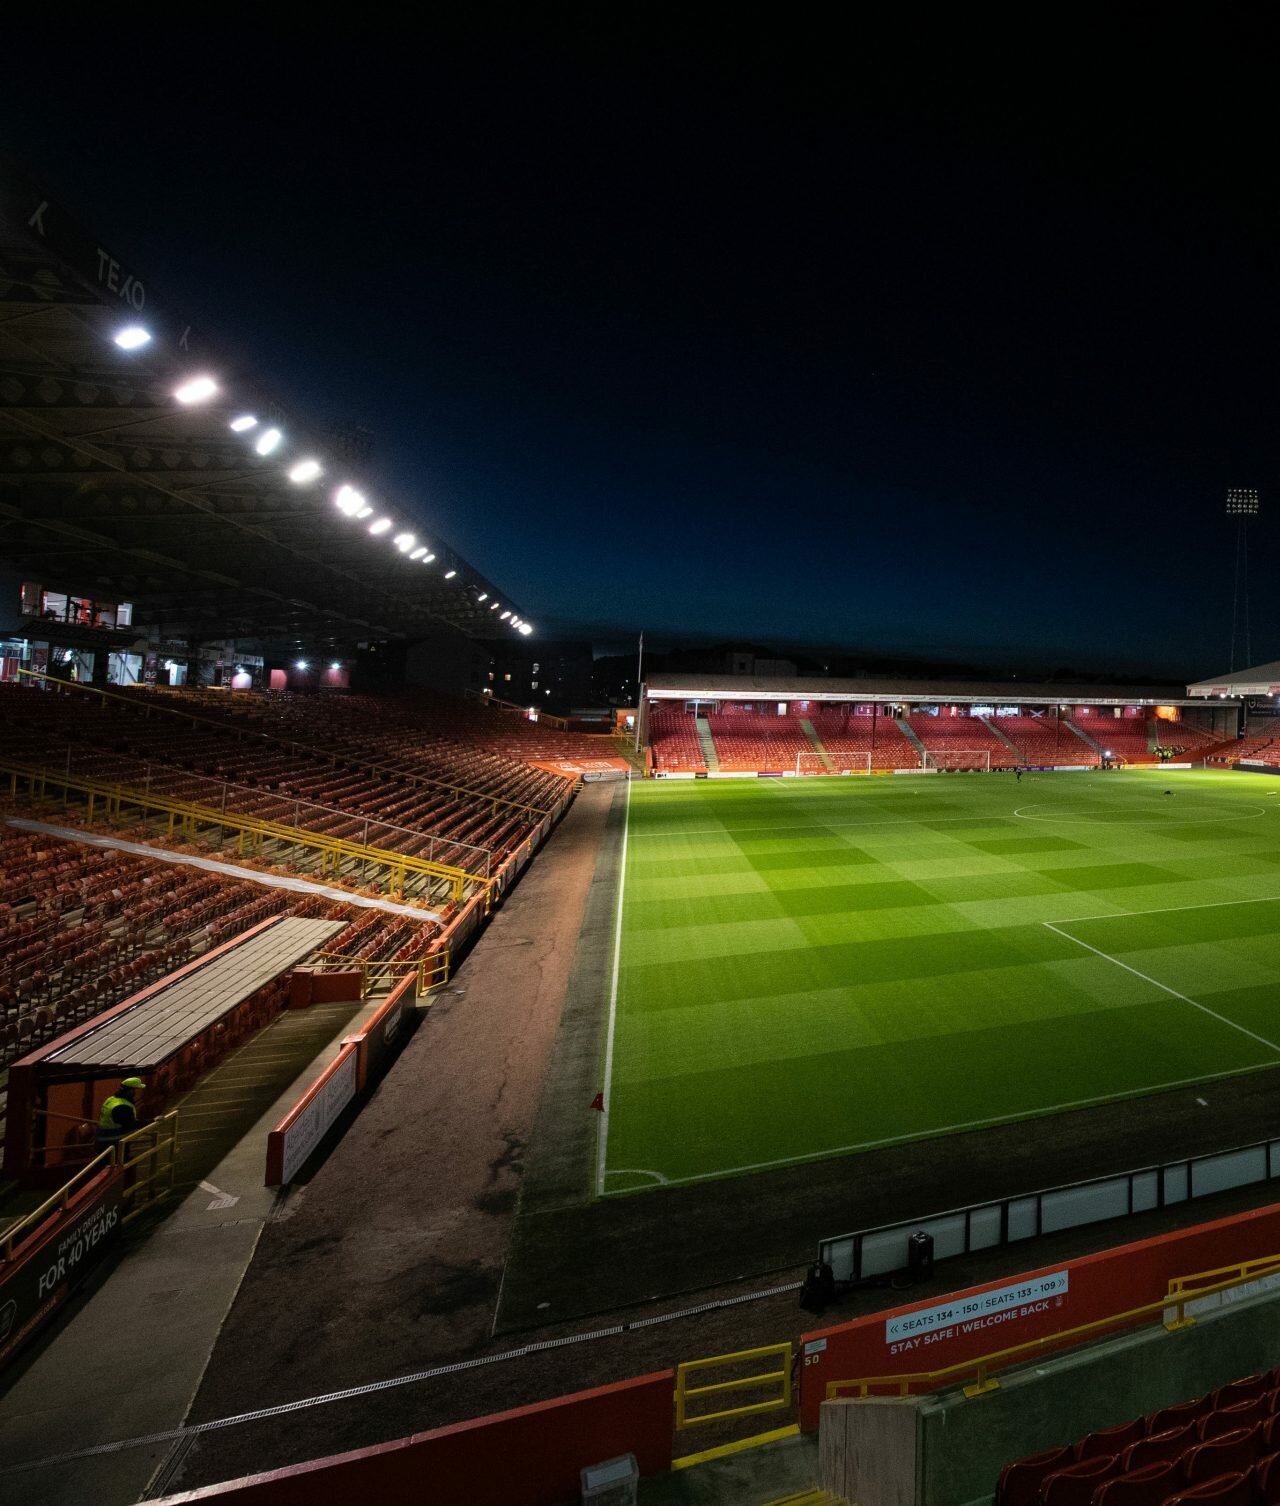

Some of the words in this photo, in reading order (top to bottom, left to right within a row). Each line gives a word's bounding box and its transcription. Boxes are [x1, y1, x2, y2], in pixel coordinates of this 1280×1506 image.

[97, 247, 145, 311] TEXO
[38, 1257, 66, 1300] FOR
[68, 1239, 83, 1267] 40
[85, 1205, 119, 1252] YEARS
[59, 1226, 83, 1256] FAMILY
[83, 1204, 105, 1233] DRIVEN
[890, 1338, 921, 1355] STAY
[924, 1328, 953, 1346] SAFE
[962, 1309, 1018, 1334] WELCOME
[1020, 1300, 1049, 1318] BACK
[902, 1316, 934, 1332] SEATS
[937, 1309, 953, 1322] 134
[963, 1303, 979, 1315] 150
[985, 1292, 1015, 1308] SEATS
[1017, 1287, 1032, 1299] 133
[1040, 1281, 1056, 1293] 109
